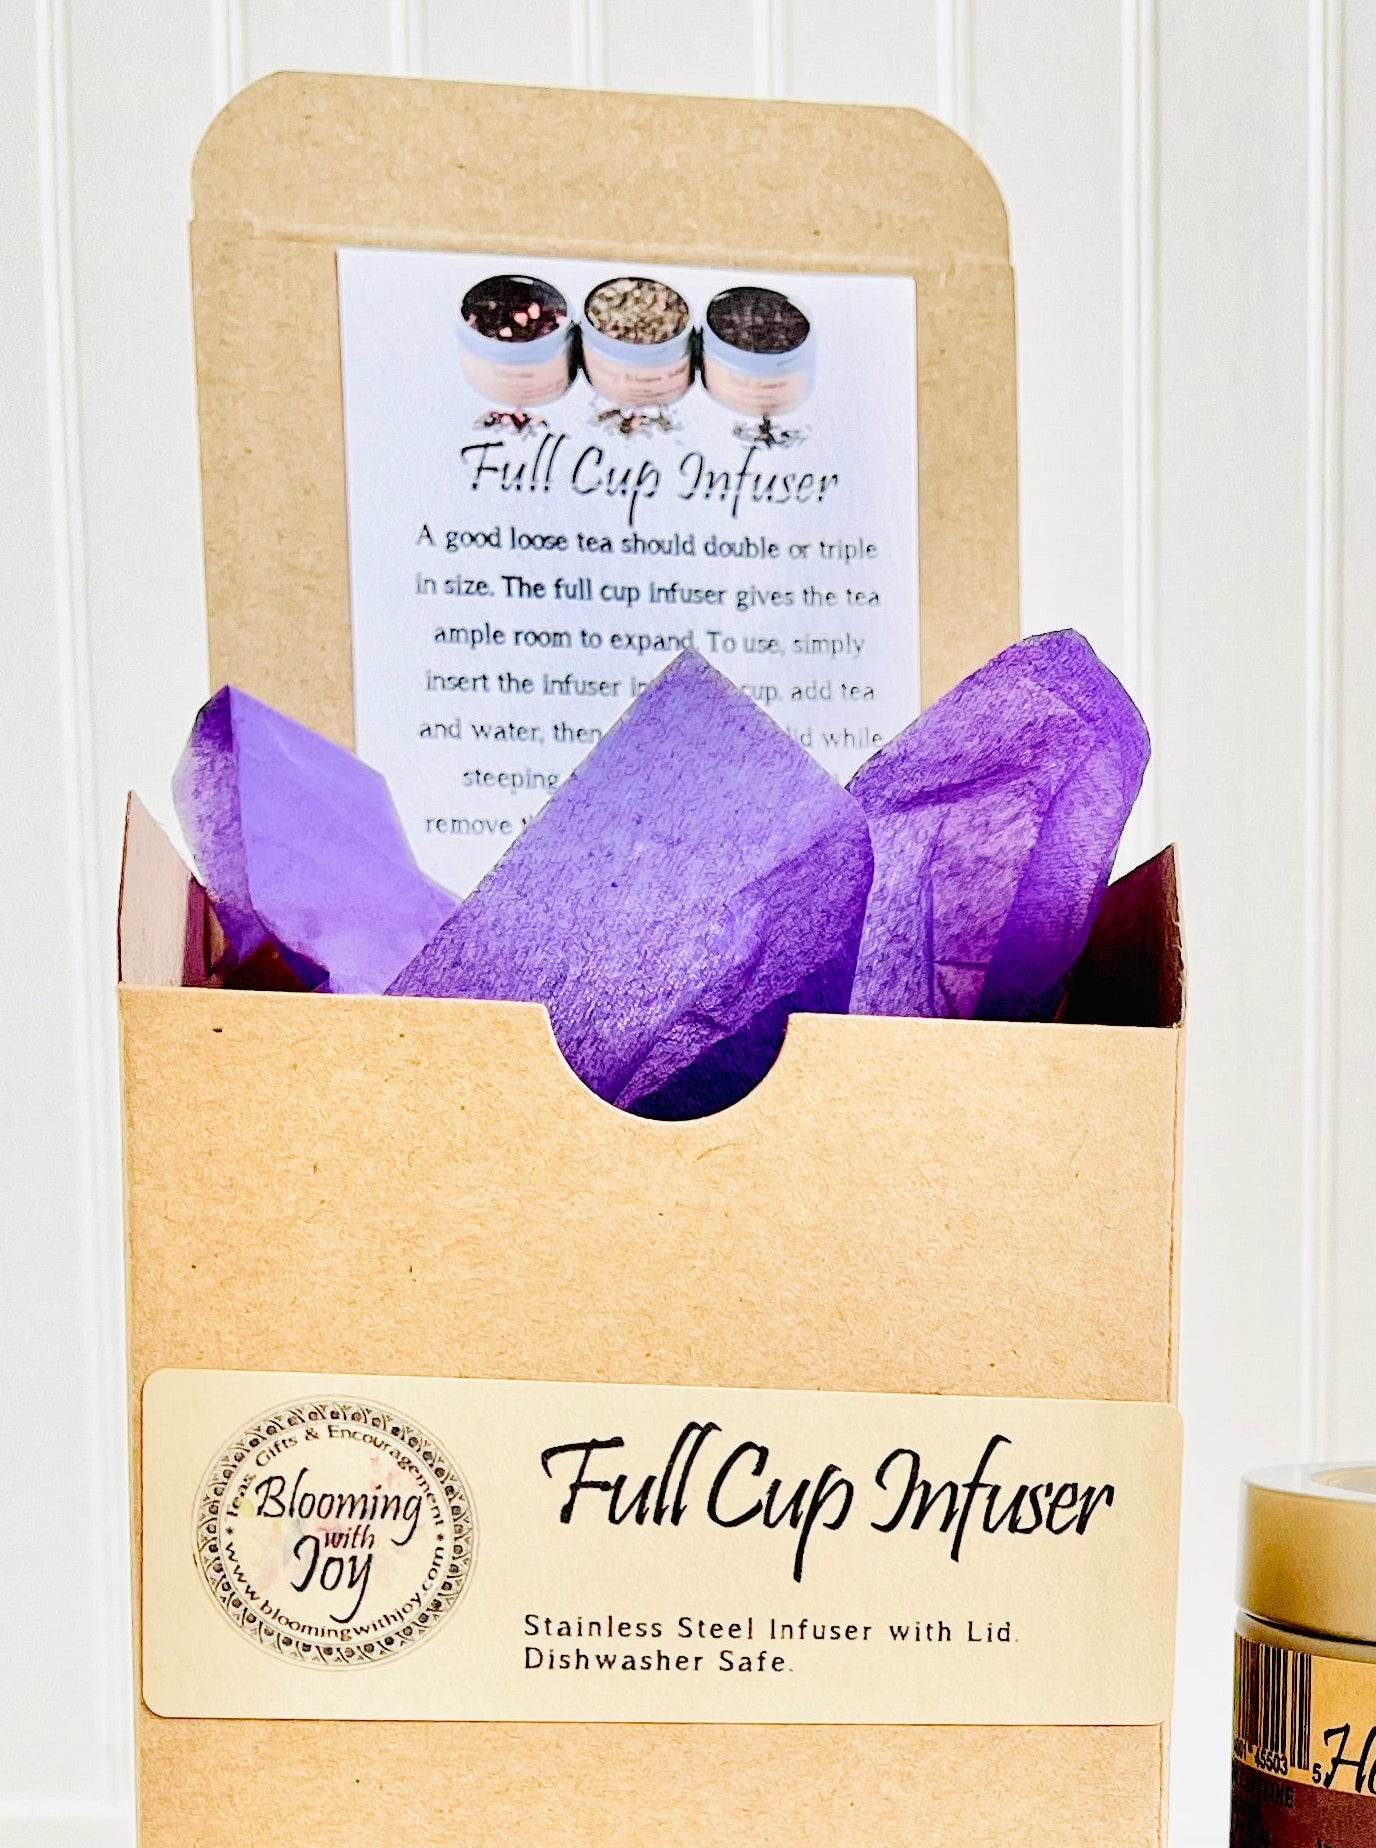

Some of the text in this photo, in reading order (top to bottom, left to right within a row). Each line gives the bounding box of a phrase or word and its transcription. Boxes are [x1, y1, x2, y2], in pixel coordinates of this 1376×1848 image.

[461, 433, 838, 527] Full Cup Infuser
[415, 524, 879, 565] A good loose tea should double or triple
[415, 572, 437, 595] in
[444, 574, 495, 596] size.
[501, 575, 547, 598] The
[553, 577, 593, 600] full
[600, 584, 640, 607] cup
[736, 586, 794, 611] gives
[802, 585, 837, 606] the
[846, 588, 881, 606] tea
[434, 623, 506, 650] ample
[514, 631, 571, 647] room
[580, 630, 603, 648] to
[707, 630, 736, 651] To
[744, 638, 786, 656] use,
[794, 633, 866, 658] simply
[426, 669, 490, 692] insert
[498, 672, 535, 694] the
[543, 673, 622, 697] infuser
[791, 680, 832, 700] add
[841, 683, 875, 700] tea
[419, 718, 462, 740] and
[471, 722, 545, 744] water,
[553, 721, 602, 744] then
[822, 727, 883, 749] while
[462, 768, 560, 795] steeping
[426, 817, 513, 835] remove
[225, 1424, 444, 1526] Teas Gifts & Encouragement
[255, 1466, 422, 1546] Blooming
[541, 1421, 1115, 1583] Full Cup Infuser
[324, 1524, 376, 1550] with
[290, 1534, 373, 1624] Joy
[524, 1614, 1019, 1643] Stainless Steel Infuser with Lid.
[524, 1646, 794, 1673] Dishwasher Safe.
[1311, 1762, 1322, 1783] 5
